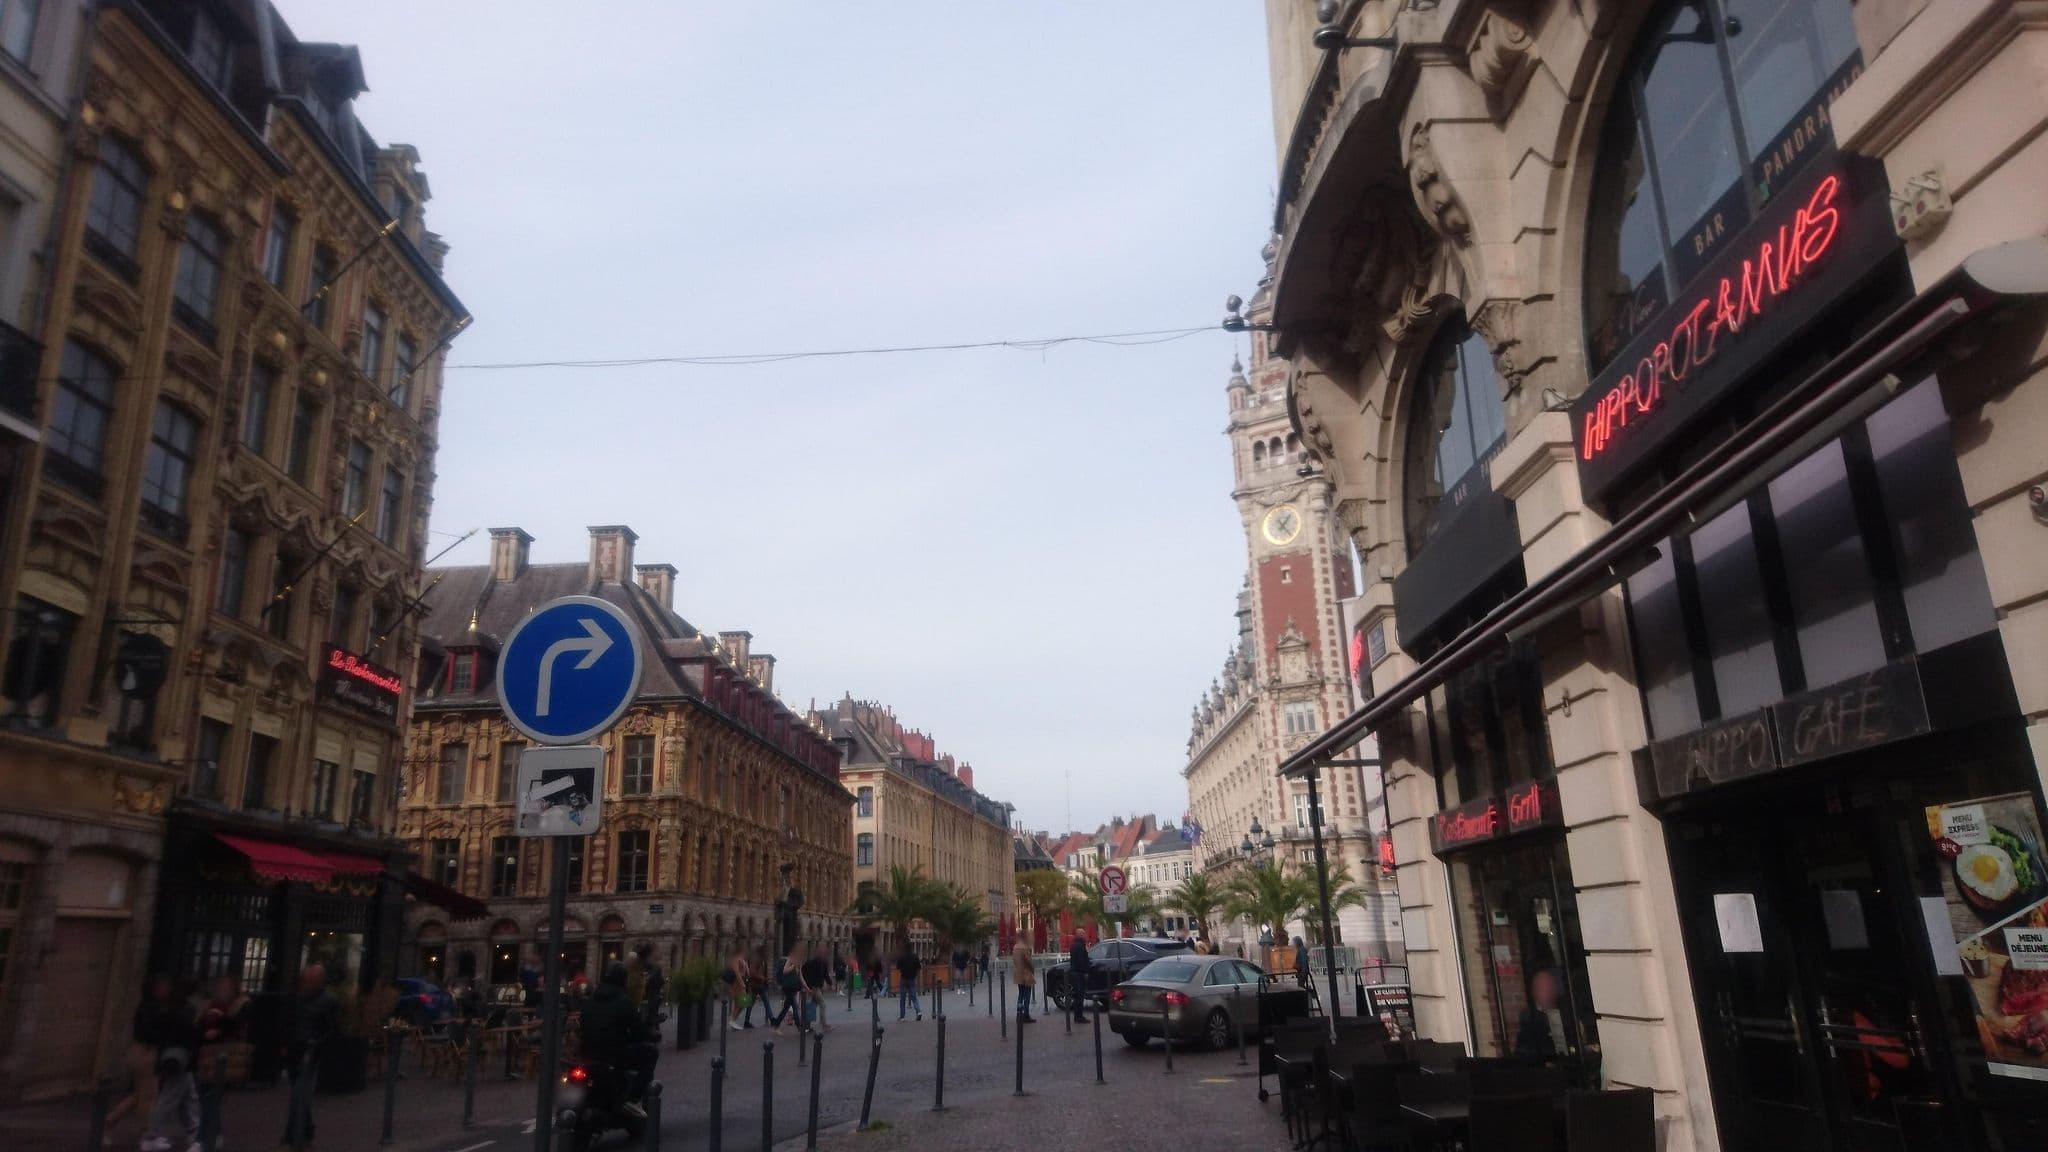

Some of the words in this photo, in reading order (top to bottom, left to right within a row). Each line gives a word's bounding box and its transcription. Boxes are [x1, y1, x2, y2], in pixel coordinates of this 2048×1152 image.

[1694, 212, 1725, 255] BAR
[1583, 175, 1839, 460] HIPPOPOTAMUS
[1952, 814, 1973, 824] MENU
[1947, 823, 1980, 834] EXPRESS
[2018, 933, 2043, 943] MENU
